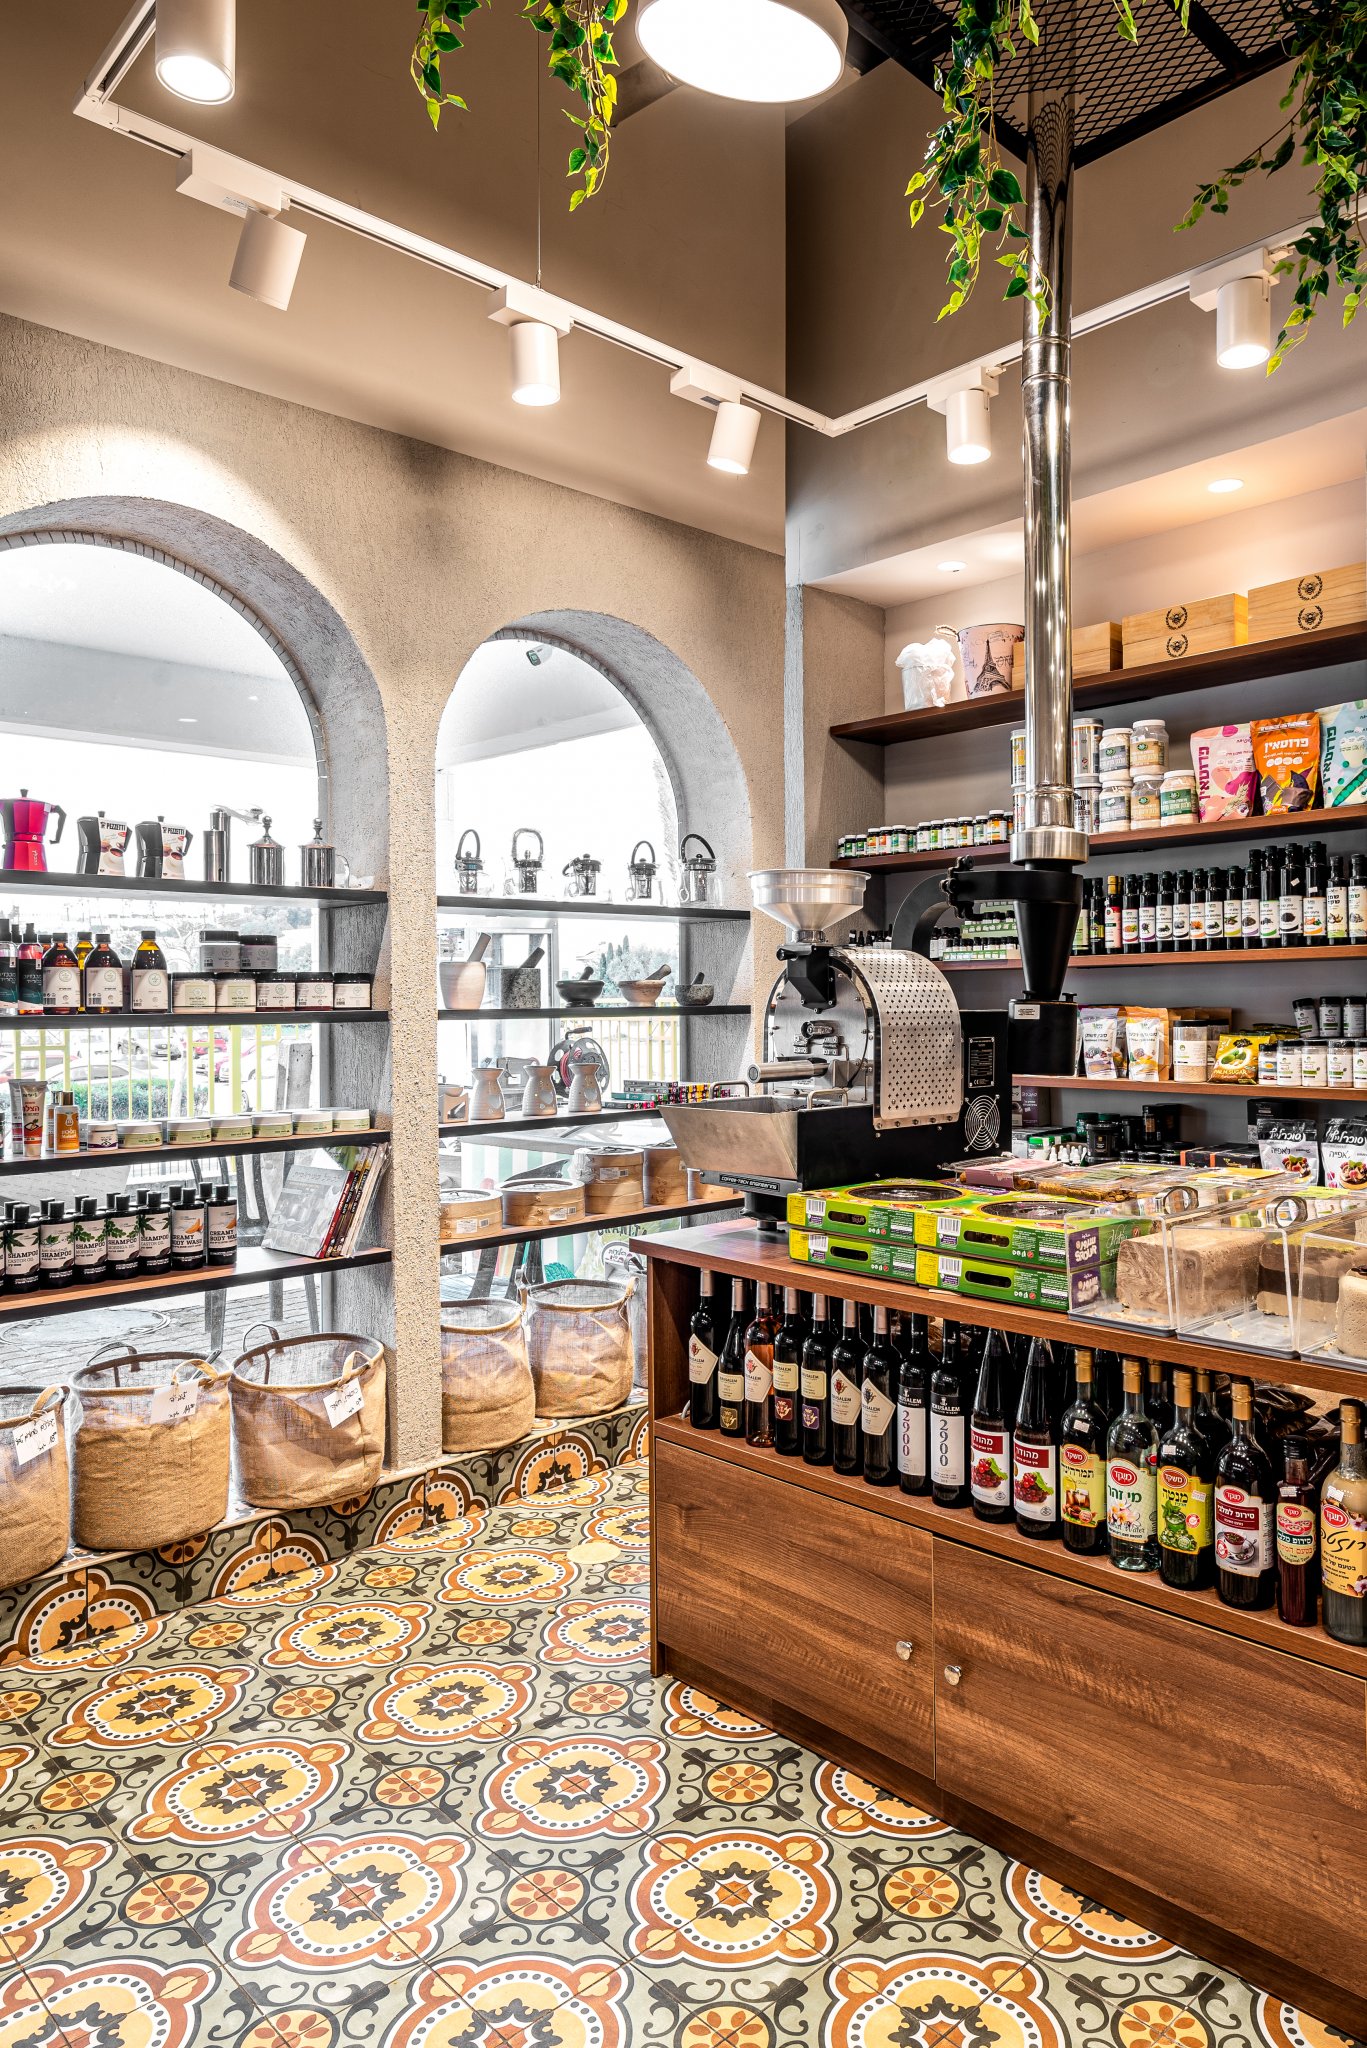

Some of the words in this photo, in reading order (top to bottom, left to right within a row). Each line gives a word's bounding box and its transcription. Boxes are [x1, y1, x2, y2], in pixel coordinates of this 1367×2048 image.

[1264, 738, 1308, 753] פרוטאין
[106, 822, 126, 832] PEZZETTI
[167, 828, 184, 836] PEZZETTI
[1074, 1246, 1097, 1262] SROUR
[902, 1410, 910, 1457] 2900
[940, 1419, 949, 1466] 2900
[1016, 1446, 1039, 1459] מהודר
[1067, 1452, 1083, 1461] משקד
[1114, 1470, 1132, 1482] משקד
[1165, 1474, 1182, 1483] משקד
[1108, 1485, 1123, 1500] זהר
[1128, 1492, 1142, 1503] מי
[1162, 1488, 1188, 1503] מנטה
[1227, 1491, 1241, 1500] משקד
[1235, 1510, 1254, 1519] סירופ
[1325, 1510, 1343, 1522] משקד
[1338, 1563, 1356, 1571] בטעם
